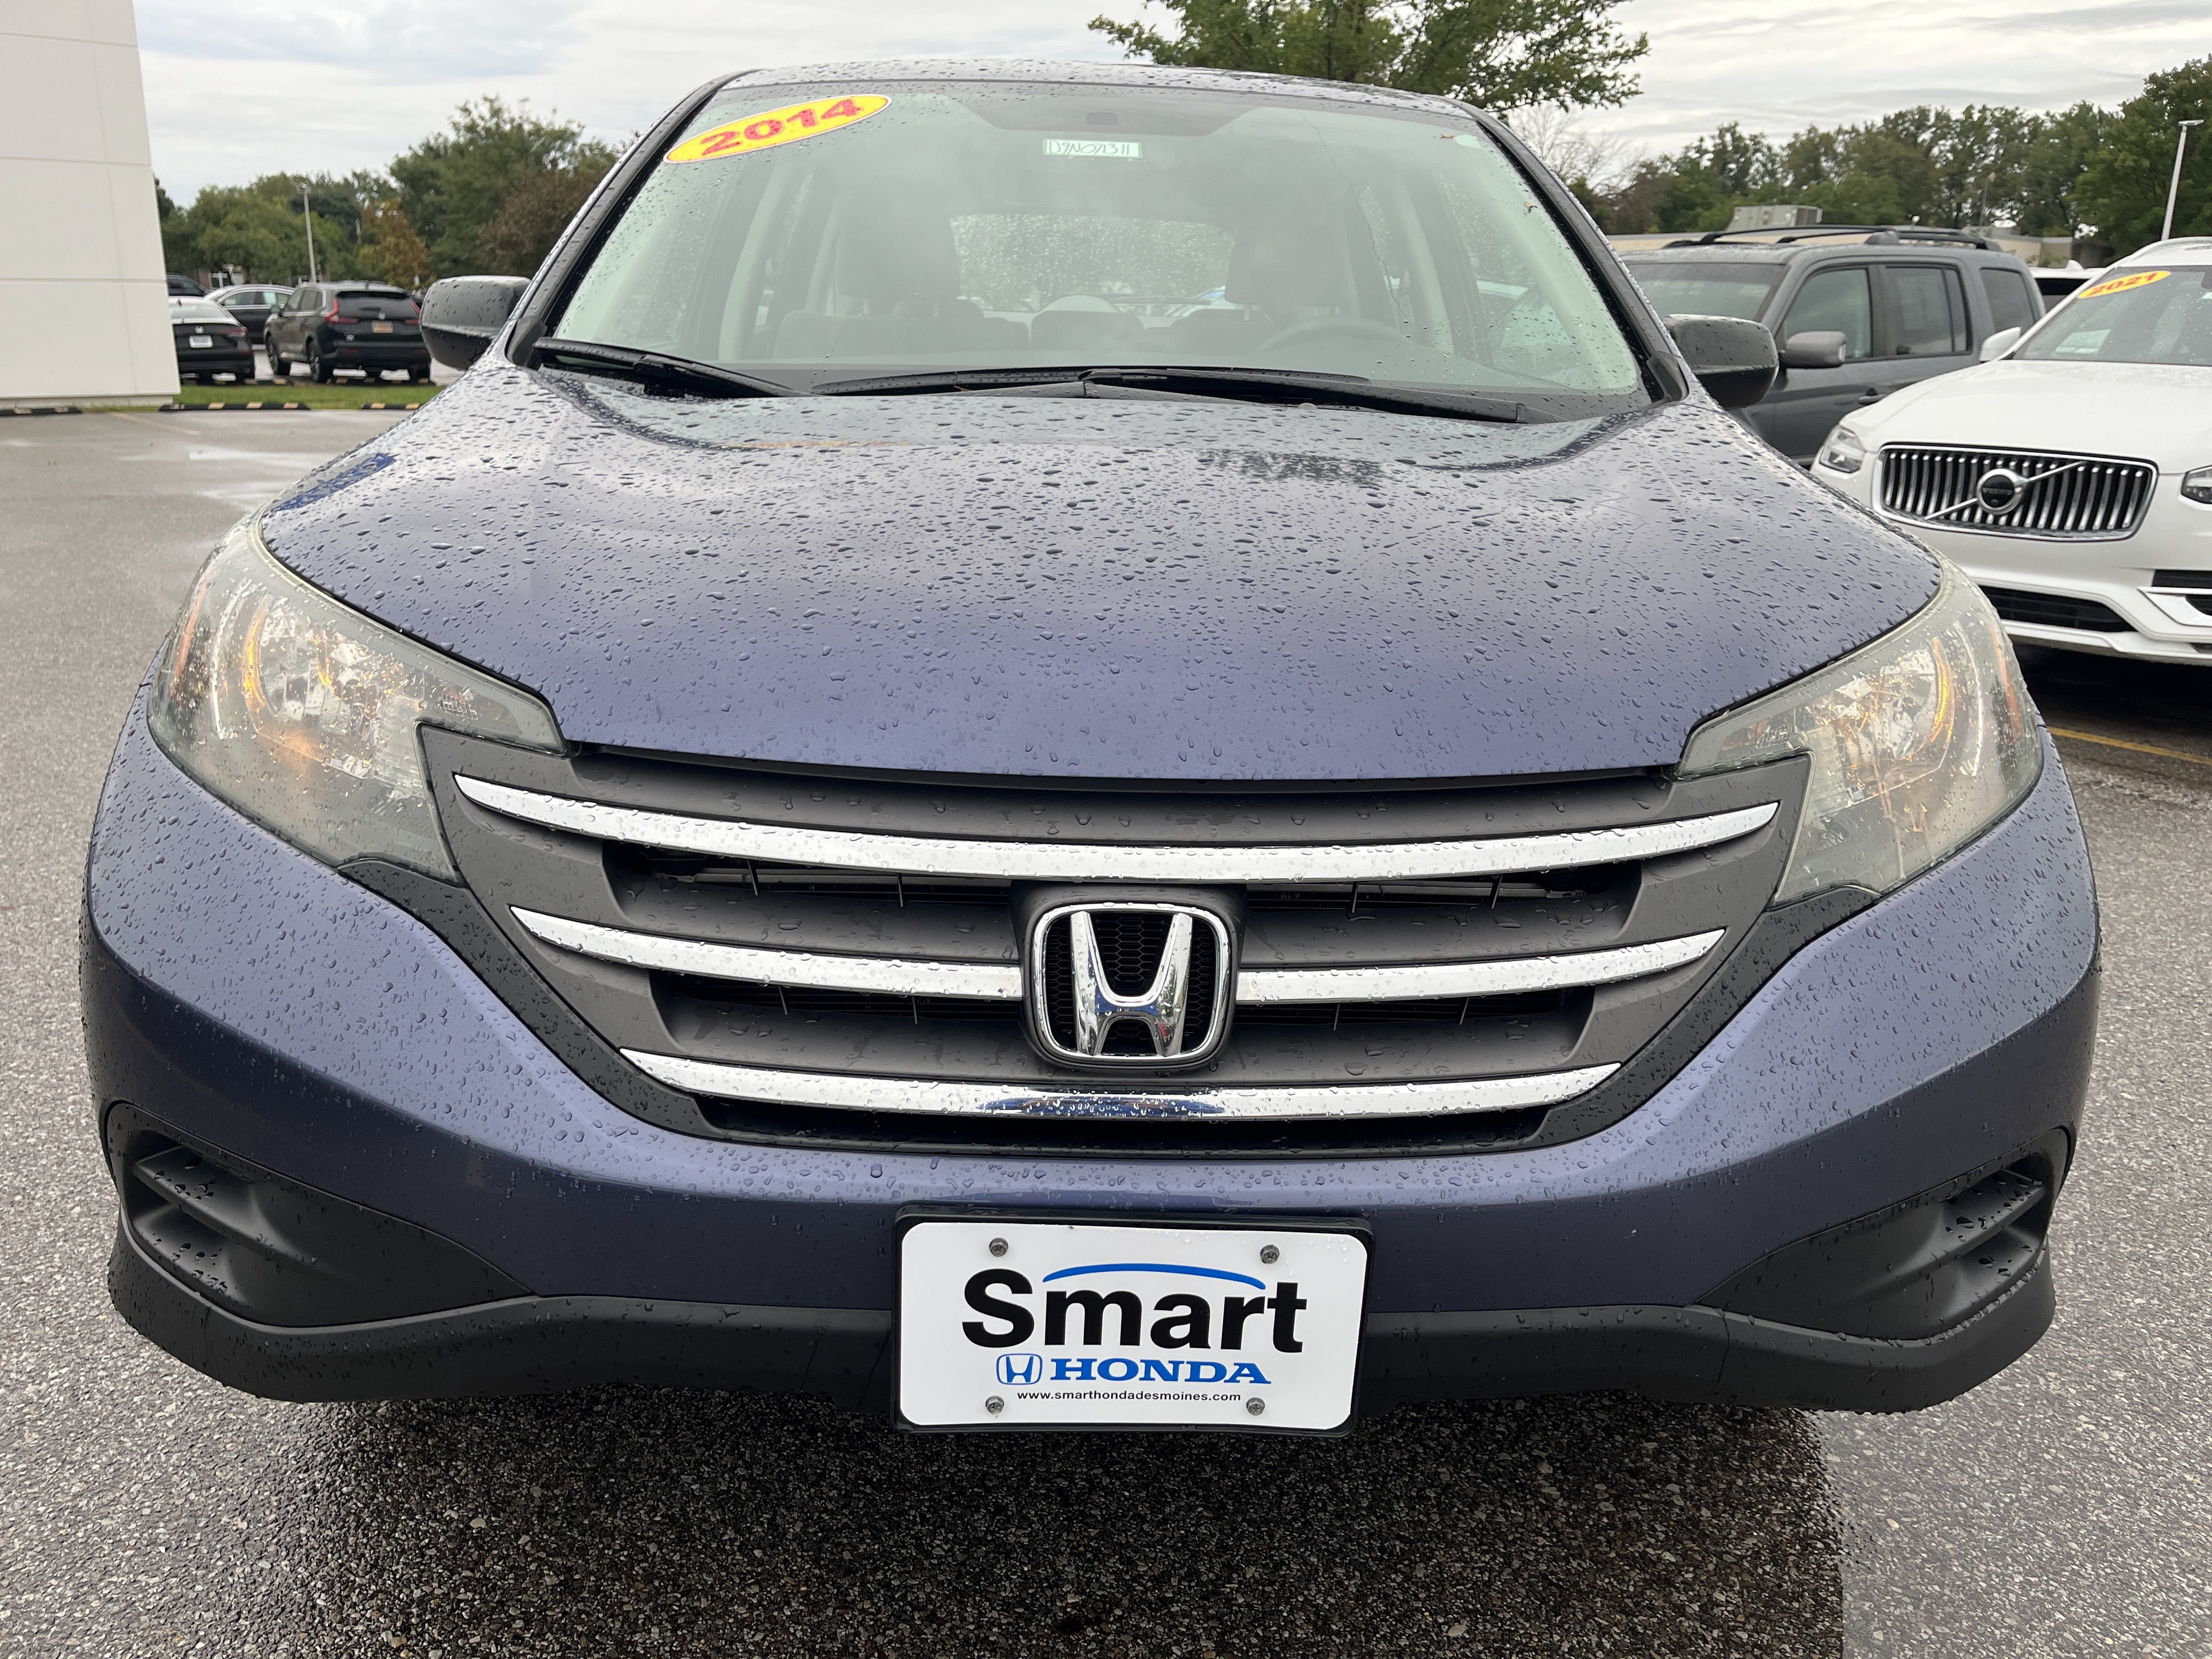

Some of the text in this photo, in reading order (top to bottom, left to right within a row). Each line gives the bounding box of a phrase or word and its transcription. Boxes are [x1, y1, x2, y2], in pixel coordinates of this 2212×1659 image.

[701, 99, 862, 156] 2014
[2087, 273, 2158, 297] 2021
[962, 1269, 1307, 1353] Smart
[1051, 1358, 1271, 1384] HONDA
[1017, 1390, 1241, 1401] www.smarthondadesmoines.com
